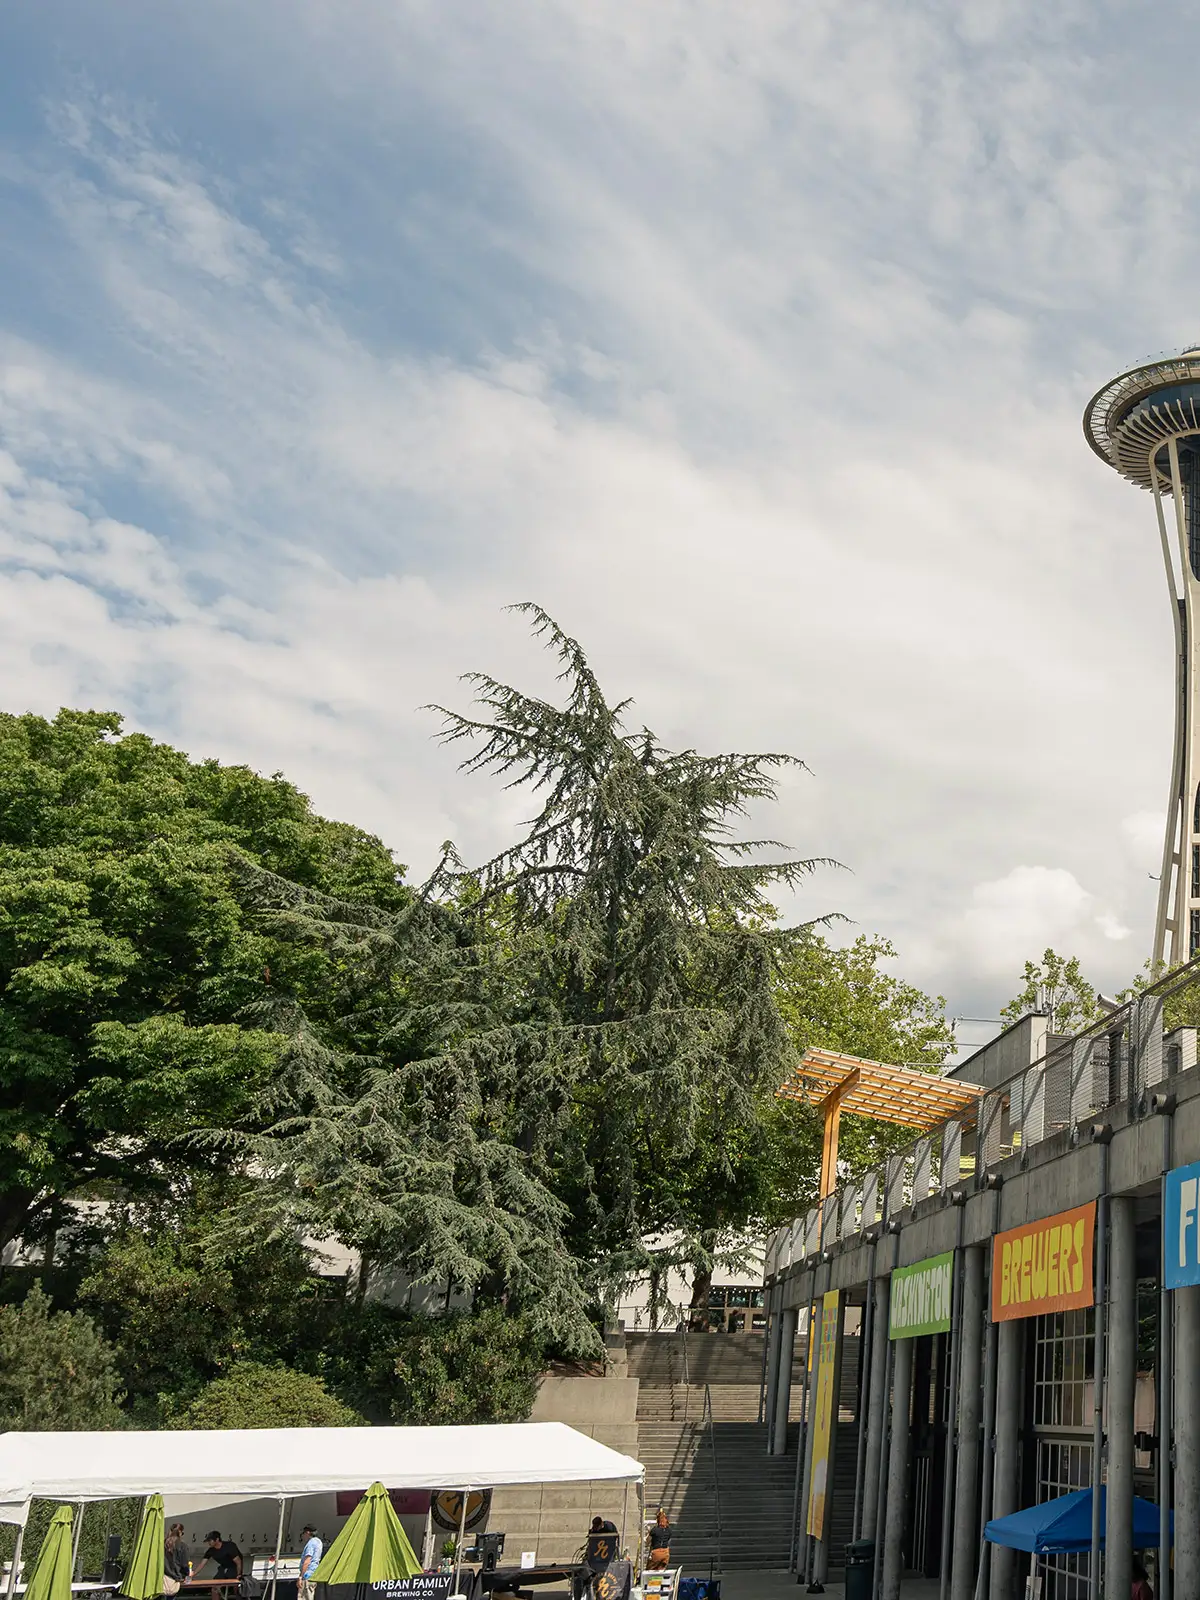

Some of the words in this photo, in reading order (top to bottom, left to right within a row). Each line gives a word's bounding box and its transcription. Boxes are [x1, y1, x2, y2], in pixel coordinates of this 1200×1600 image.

[1001, 1218, 1085, 1307] BREWERS
[891, 1262, 951, 1329] WASHINGTON
[372, 1579, 410, 1590] URBAN
[412, 1577, 451, 1589] FAMILY
[386, 1590, 420, 1598] BREWING
